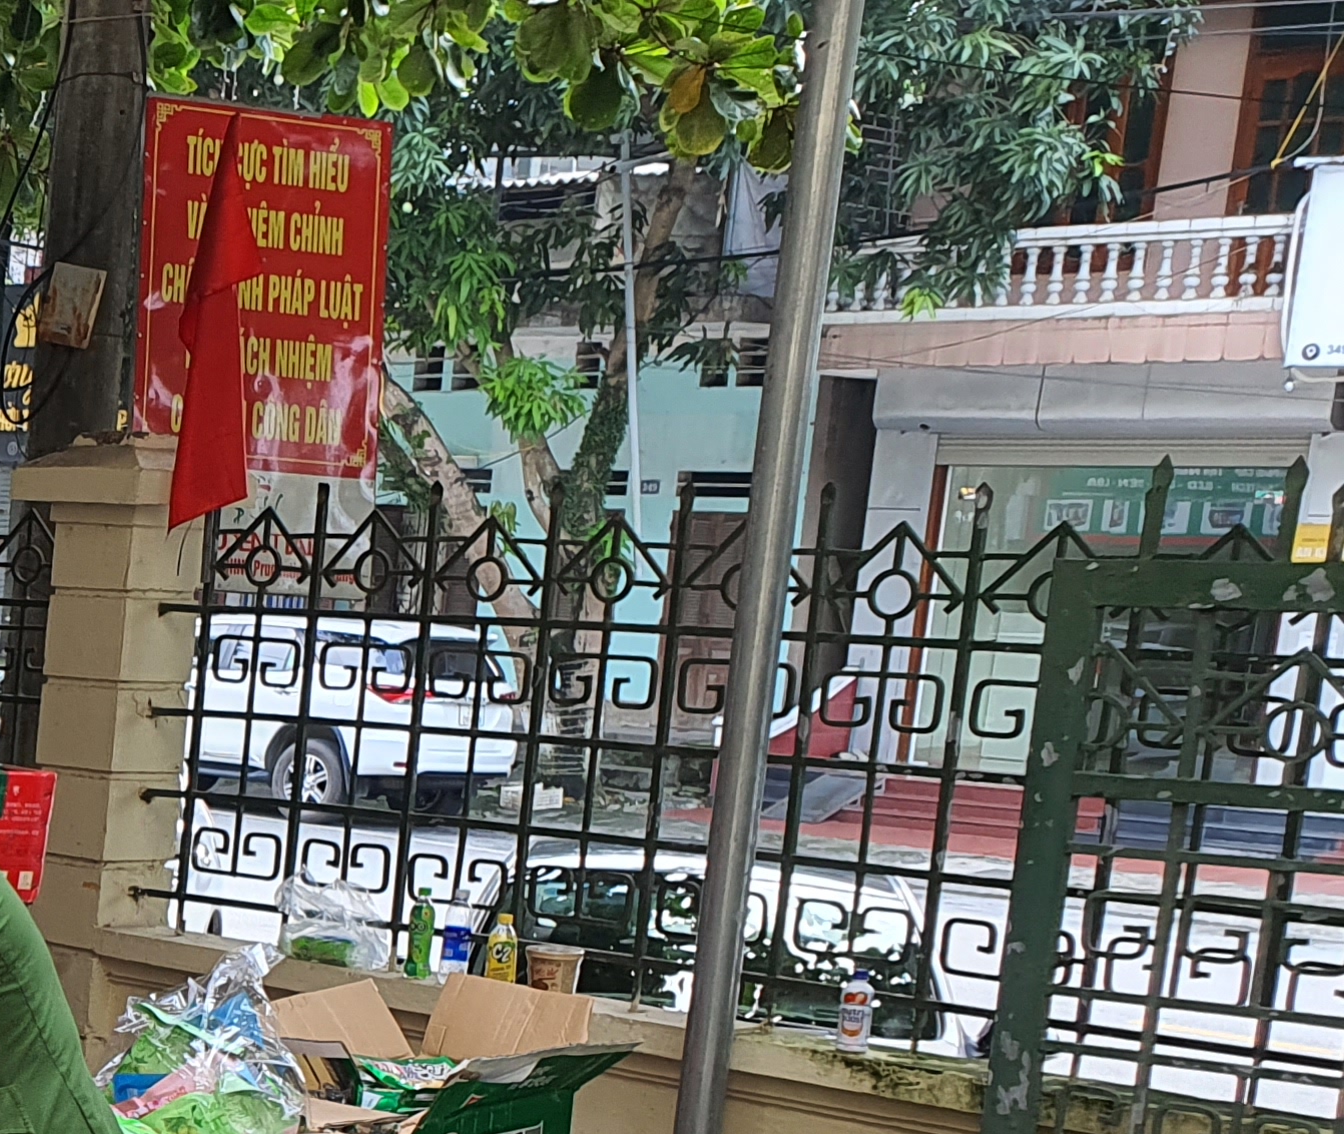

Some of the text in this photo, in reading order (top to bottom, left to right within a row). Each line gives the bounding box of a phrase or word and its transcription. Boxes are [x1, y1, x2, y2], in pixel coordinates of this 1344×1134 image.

[273, 137, 304, 188] TÌM
[309, 137, 351, 193] HIỂU
[289, 200, 346, 256] CHỈNH
[268, 269, 364, 330] PHÁP LUẬT
[275, 332, 333, 383] NHIỆM
[304, 394, 343, 447] DÂN
[491, 944, 512, 963] C2
